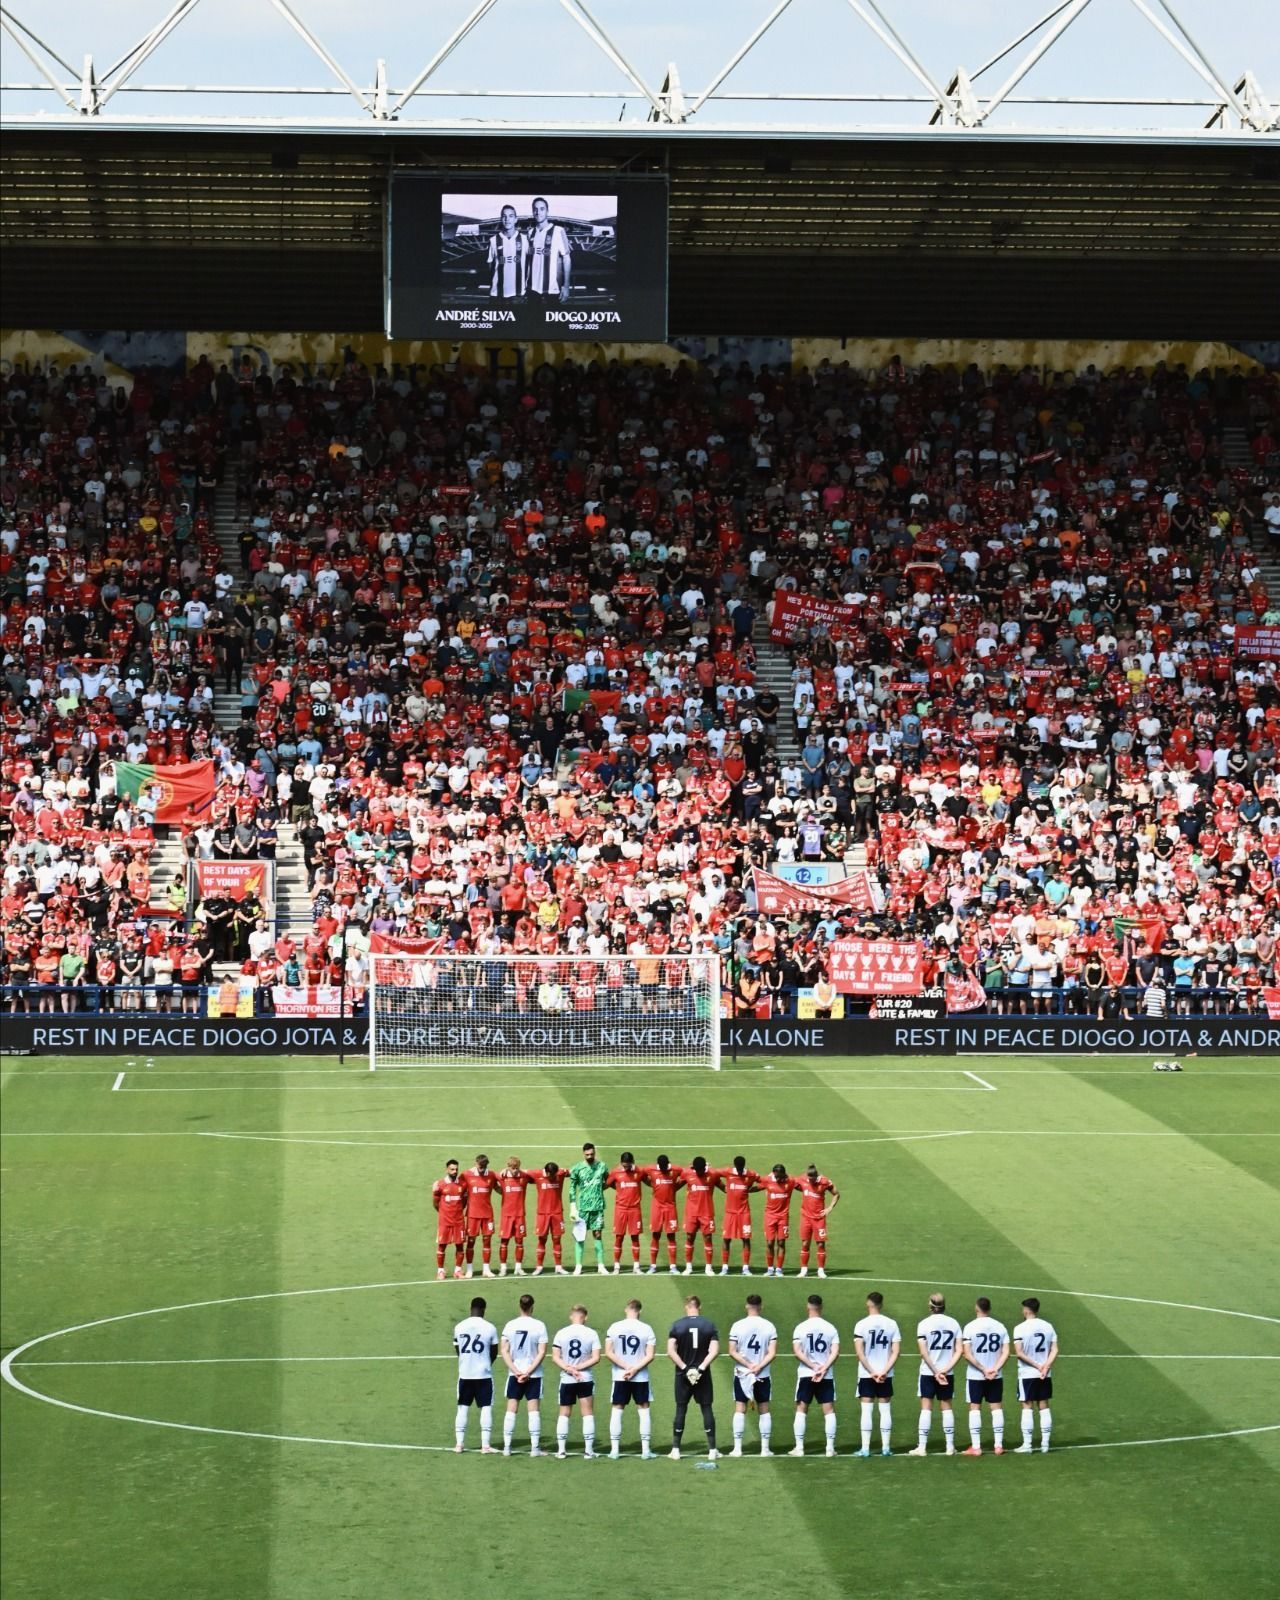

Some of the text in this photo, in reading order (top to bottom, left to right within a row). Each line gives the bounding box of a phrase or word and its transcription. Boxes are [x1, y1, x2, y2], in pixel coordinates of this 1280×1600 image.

[435, 308, 516, 322] ANDRÉ SILVA
[545, 311, 621, 323] DIOGO JOTA
[806, 600, 811, 608] A
[815, 602, 829, 611] LAD
[833, 606, 853, 615] FROM
[312, 704, 327, 717] 20
[804, 829, 819, 843] 20
[203, 865, 250, 875] BEST DAYS
[796, 870, 810, 881] 12
[203, 878, 240, 887] OF YOUR
[833, 942, 917, 955] THOSE WERE THE
[832, 970, 914, 983] DAYS MY FRIEND
[576, 985, 592, 998] 20
[276, 1004, 325, 1013] THORNTON
[894, 999, 912, 1008] #20
[877, 1009, 938, 1018] UTE & FAMILY
[34, 1028, 88, 1046] REST
[95, 1028, 116, 1046] IN
[124, 1028, 196, 1046] PEACE
[203, 1028, 277, 1046] DIOGO
[283, 1028, 337, 1046] JOTA
[343, 1028, 357, 1046] &
[517, 1028, 594, 1046] YOU'LL
[601, 1028, 675, 1046] NEVER
[748, 1028, 824, 1047] ALONE
[896, 1028, 950, 1046] REST
[956, 1028, 977, 1046] IN
[984, 1028, 1055, 1046] PEACE
[1062, 1029, 1135, 1047] DIOGO
[1139, 1029, 1193, 1047] JOTA
[1198, 1029, 1213, 1047] &
[461, 1333, 484, 1355] 26
[516, 1330, 528, 1350] 7
[619, 1334, 640, 1355] 19
[688, 1327, 698, 1349] 1
[748, 1334, 761, 1355] 4
[807, 1333, 827, 1354] 16
[869, 1329, 889, 1350] 14
[930, 1330, 954, 1351] 22
[976, 1333, 1001, 1354] 28
[1035, 1332, 1046, 1353] 2
[569, 1339, 582, 1360] 8
